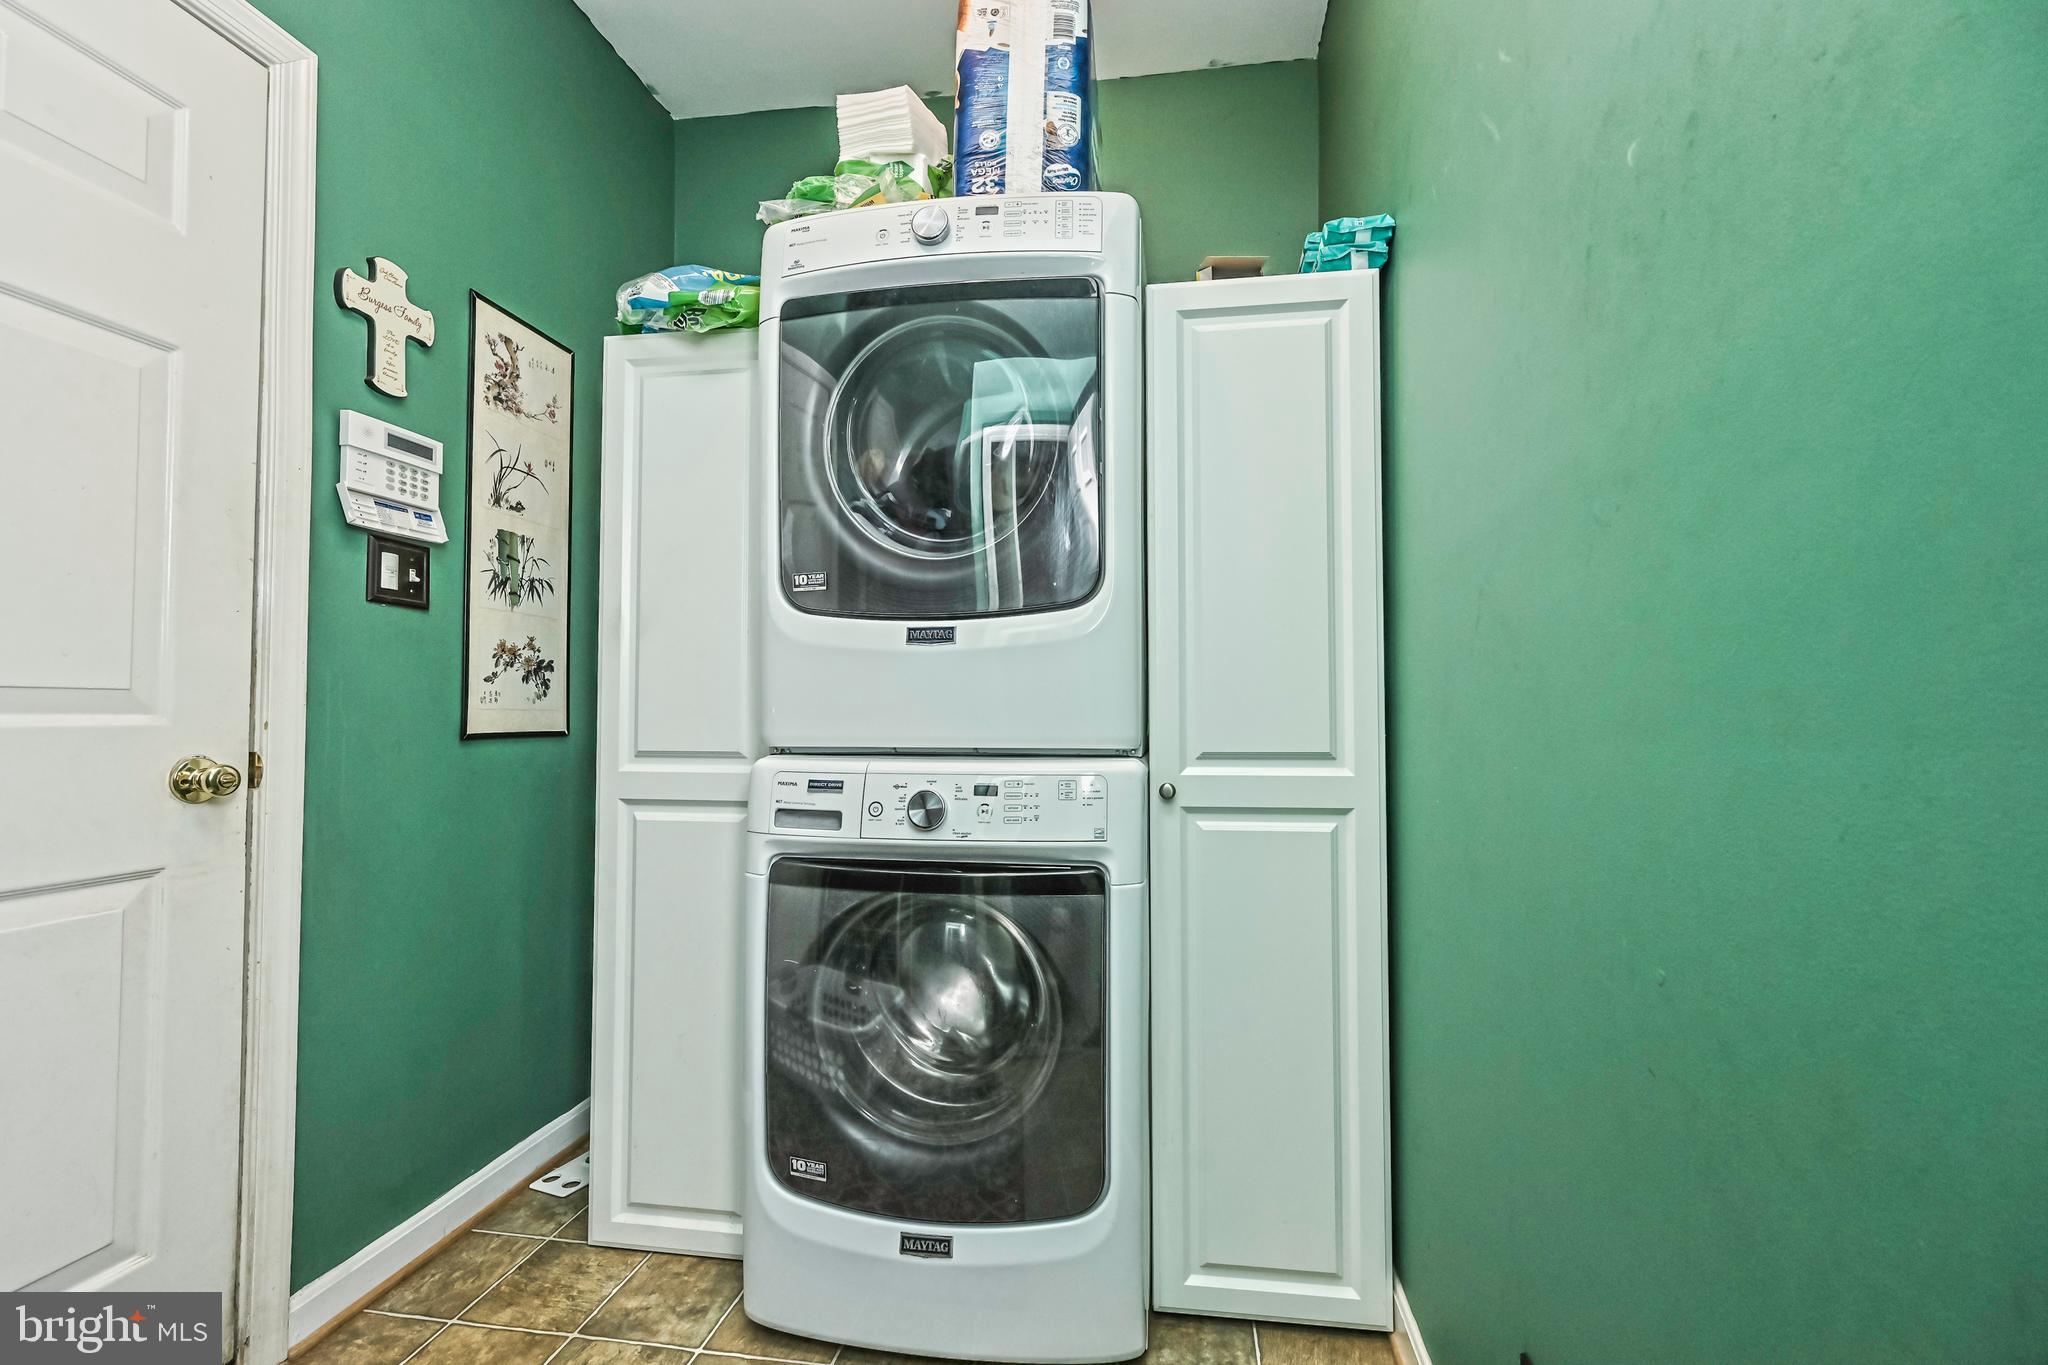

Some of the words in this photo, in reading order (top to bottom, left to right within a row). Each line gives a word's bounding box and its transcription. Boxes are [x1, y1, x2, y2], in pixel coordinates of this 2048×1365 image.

[971, 167, 1000, 176] MEGA
[971, 176, 999, 193] 32
[358, 286, 393, 313] Burgess
[393, 305, 423, 334] Family
[794, 574, 808, 586] 10
[909, 629, 953, 640] MAYTAG
[791, 1158, 806, 1172] 10
[806, 1161, 825, 1170] YEAR
[903, 1238, 949, 1253] MAYTAG
